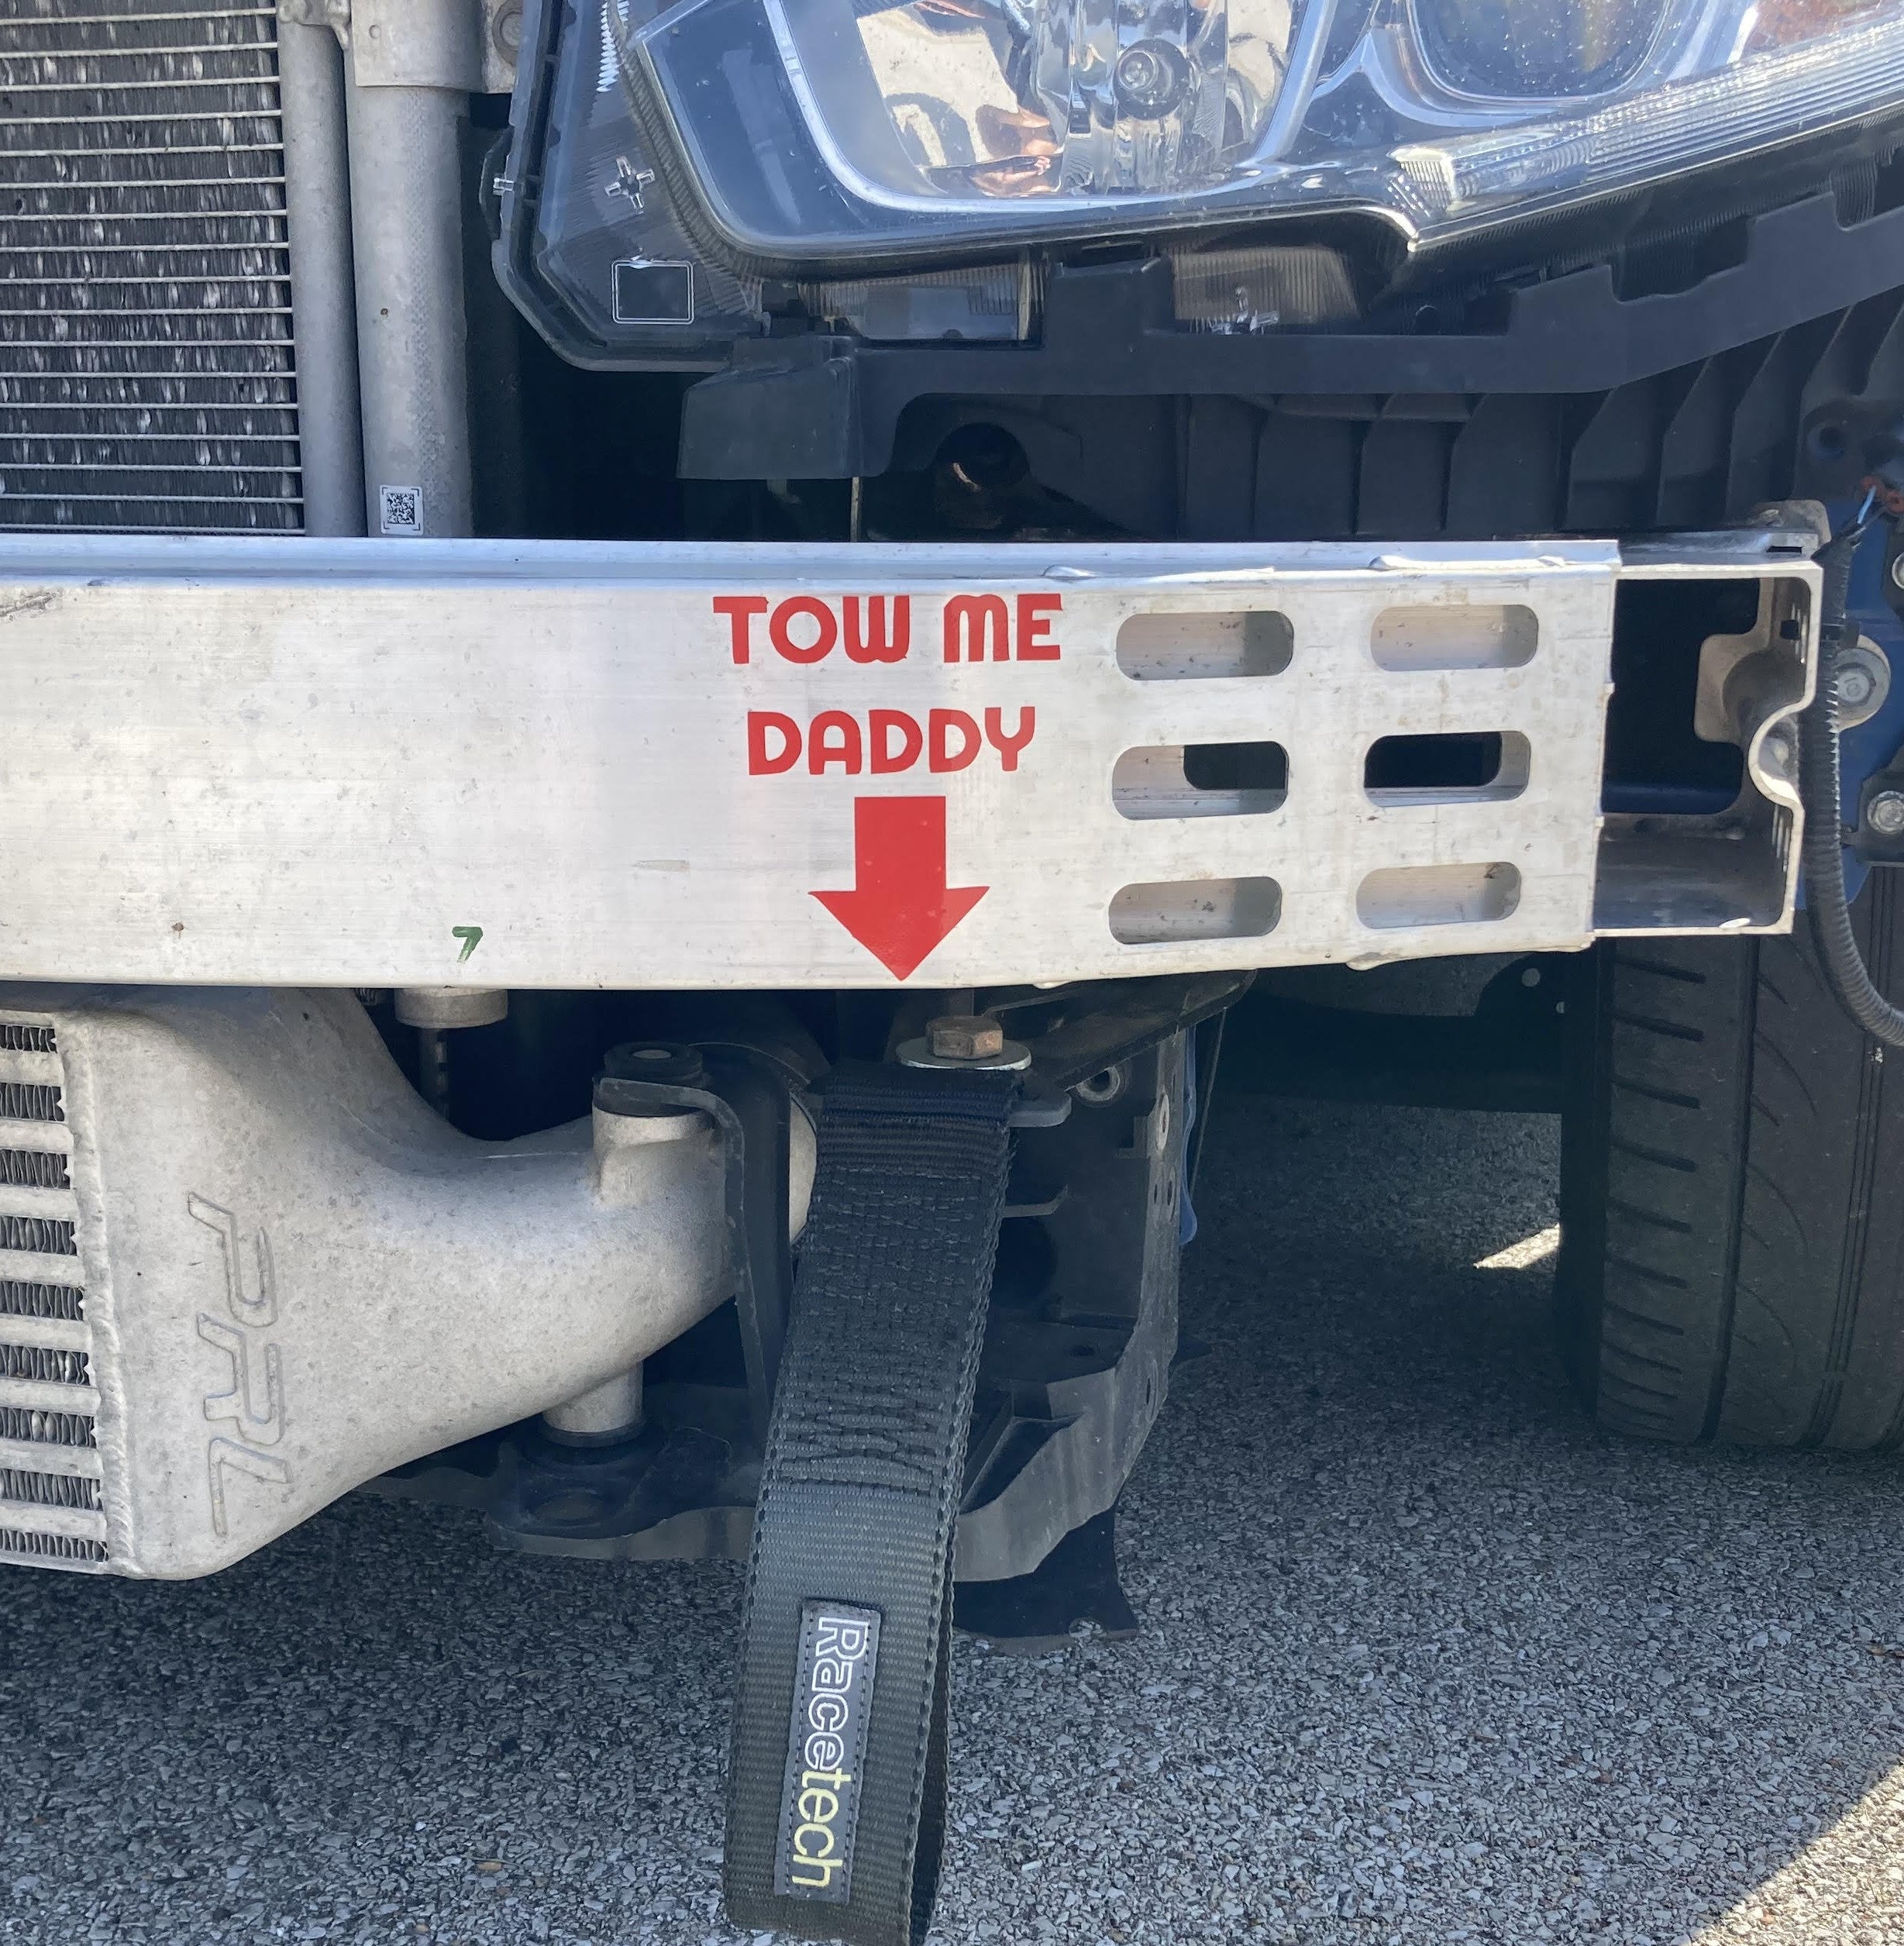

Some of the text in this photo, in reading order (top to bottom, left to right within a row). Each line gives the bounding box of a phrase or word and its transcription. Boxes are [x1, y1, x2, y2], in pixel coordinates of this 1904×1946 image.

[713, 593, 1062, 665] TOW ME
[747, 706, 1036, 777] DADDY
[791, 1616, 870, 1889] Racetech
